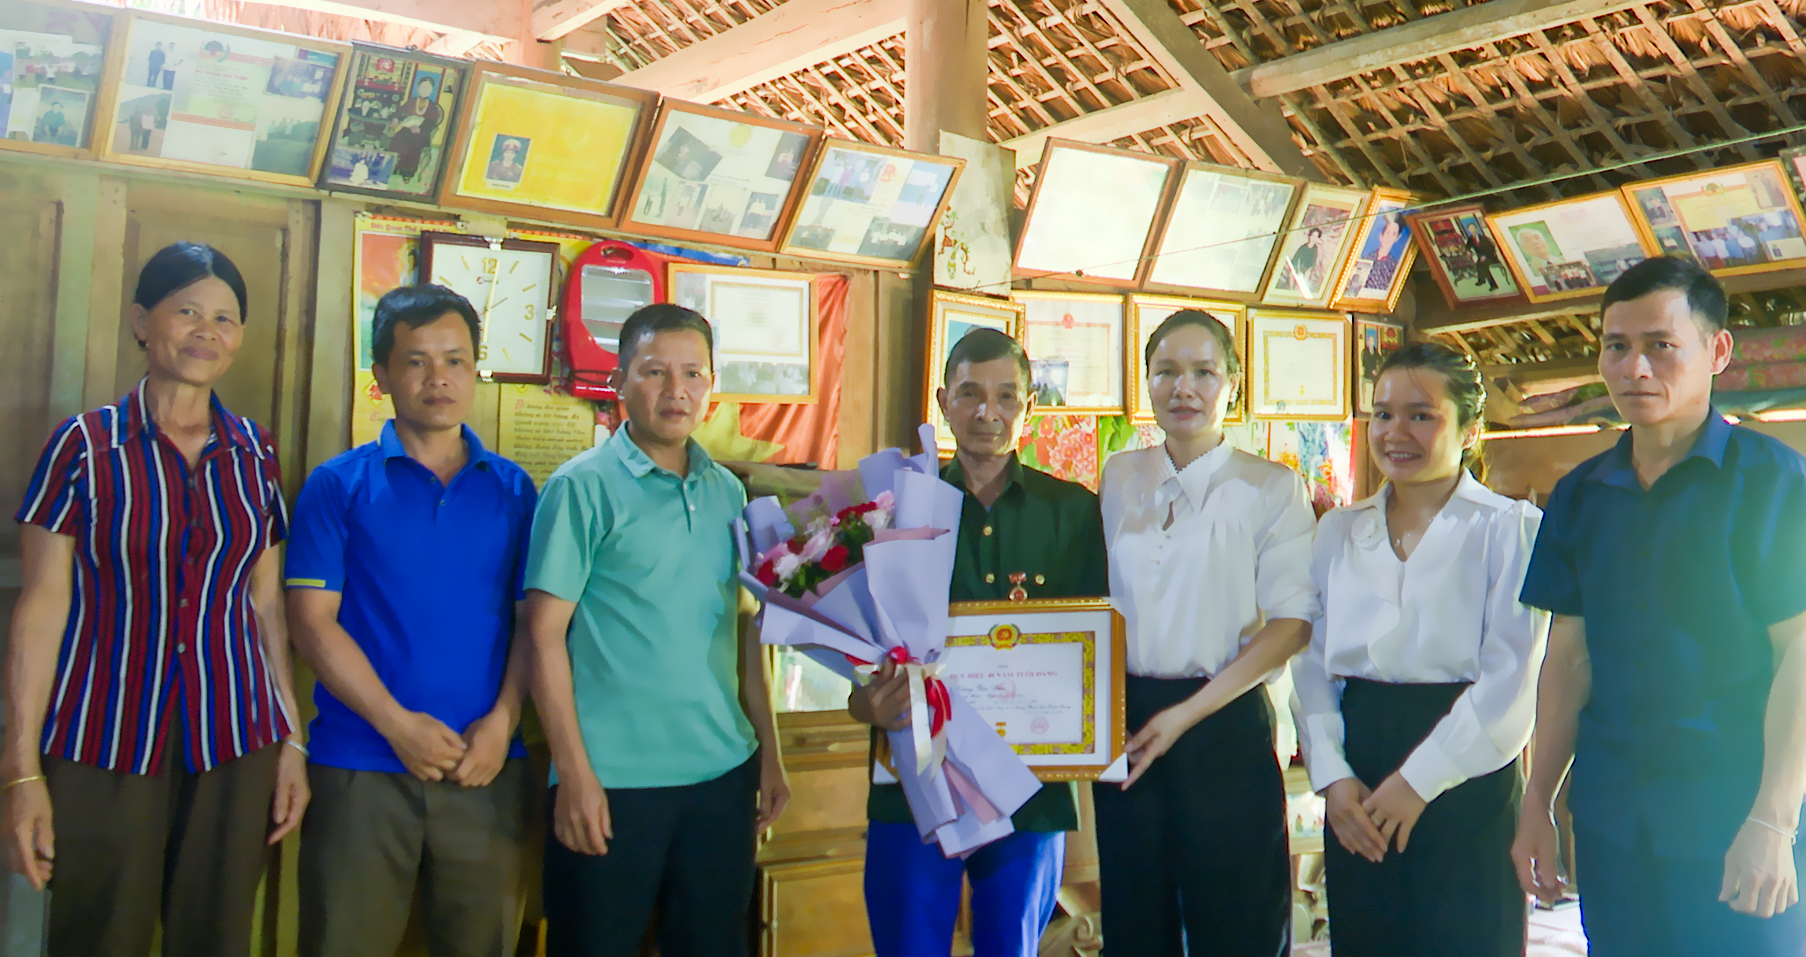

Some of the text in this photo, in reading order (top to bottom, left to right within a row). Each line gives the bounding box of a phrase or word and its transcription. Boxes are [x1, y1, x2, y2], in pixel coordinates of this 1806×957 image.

[482, 257, 497, 274] 12
[524, 304, 534, 320] 3
[478, 345, 488, 361] 6
